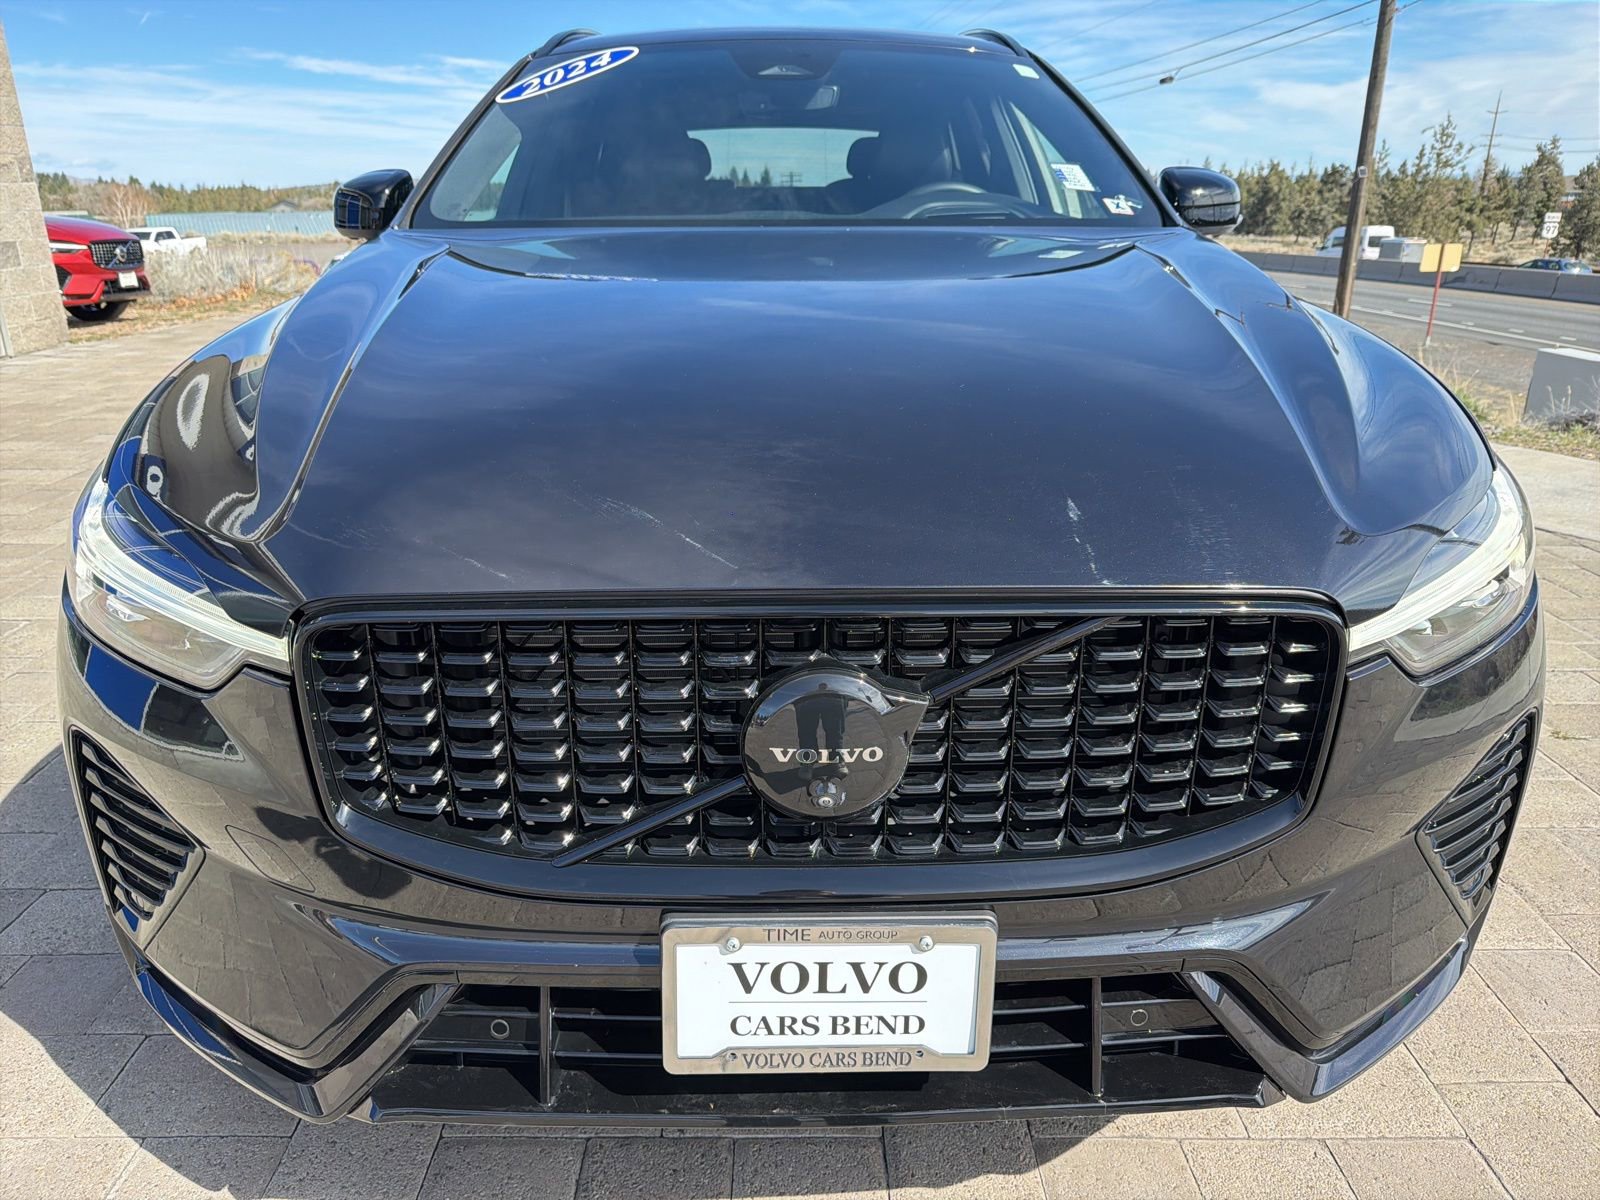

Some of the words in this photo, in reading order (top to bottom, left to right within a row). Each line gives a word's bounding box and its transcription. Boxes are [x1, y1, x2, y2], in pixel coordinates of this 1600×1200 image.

[520, 51, 612, 96] 2024
[1545, 225, 1557, 234] 97
[769, 746, 884, 764] VOLVO
[762, 928, 811, 942] TIME
[818, 931, 852, 940] AUTO
[856, 930, 898, 940] GROUP
[727, 961, 928, 994] VOLVO
[730, 1015, 820, 1036] CARS
[828, 1014, 926, 1036] BEND
[742, 1053, 805, 1069] VOLVO
[809, 1052, 857, 1068] CARS
[862, 1051, 912, 1067] BEND
